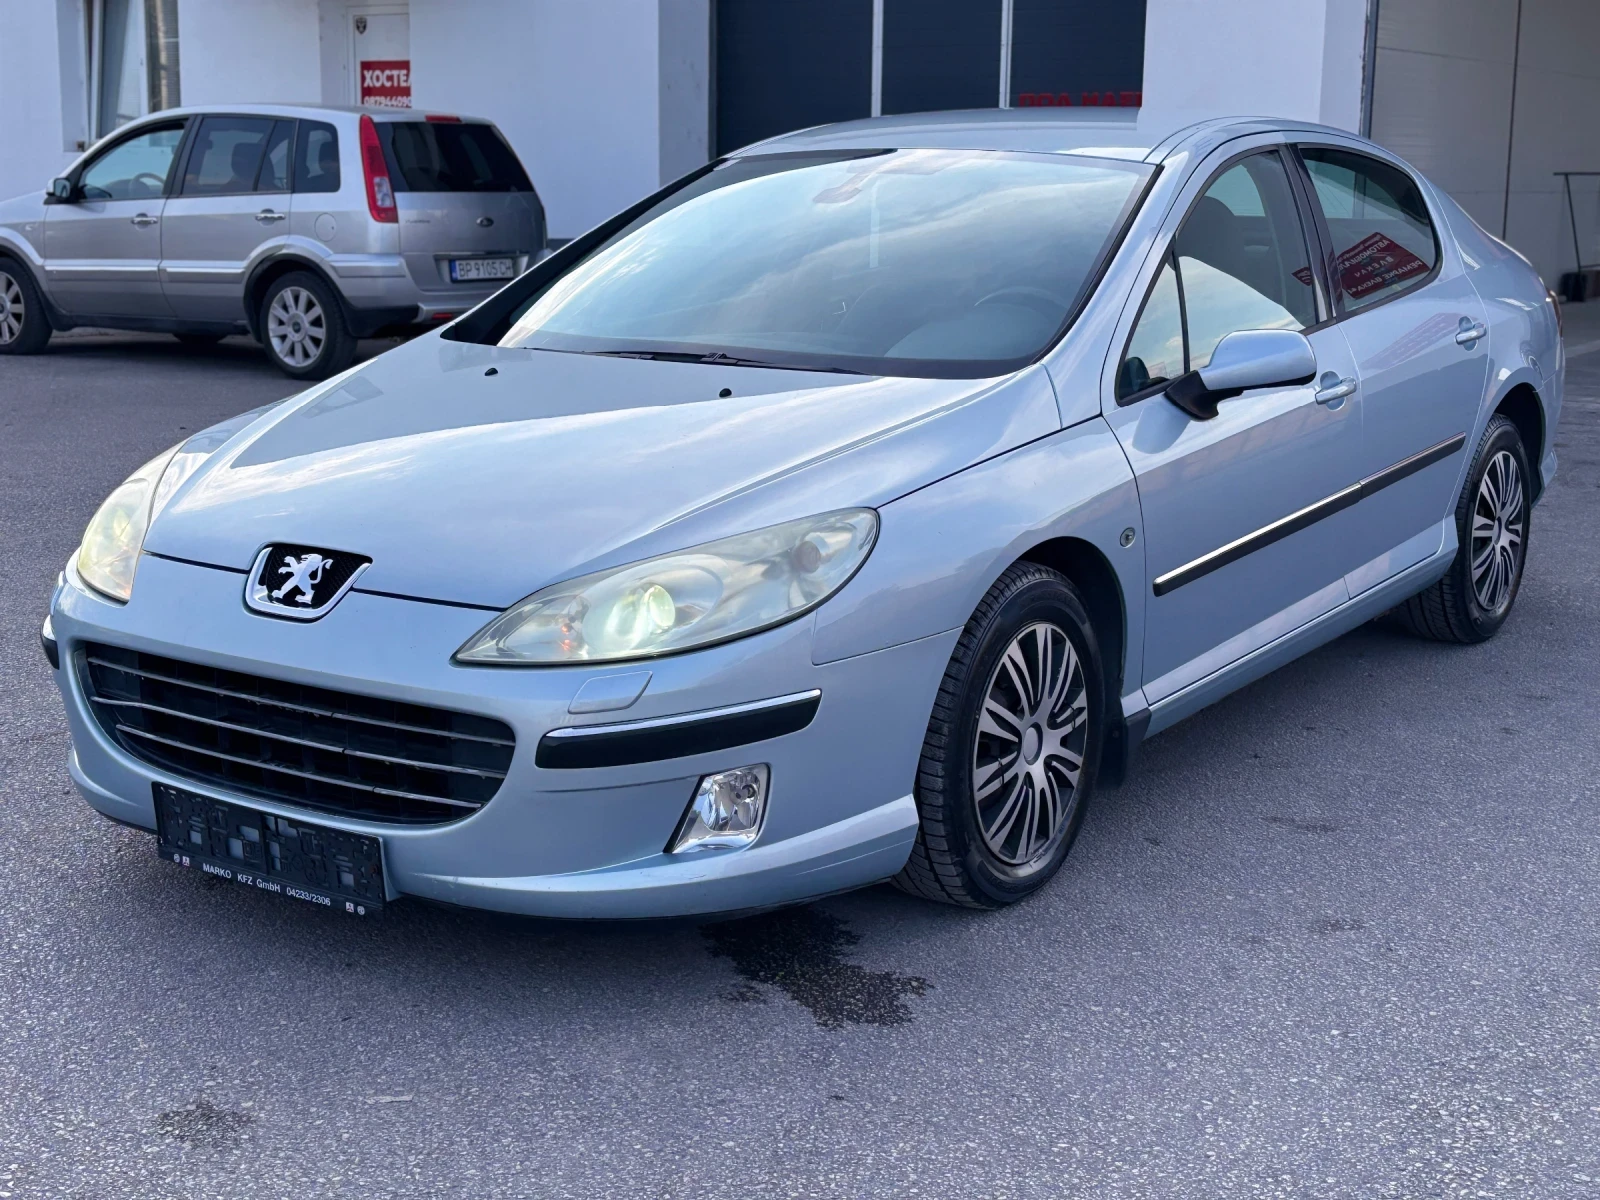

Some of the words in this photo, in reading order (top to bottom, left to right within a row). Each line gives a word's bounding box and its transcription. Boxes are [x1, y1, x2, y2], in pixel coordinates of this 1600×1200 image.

[458, 262, 472, 278] BP
[474, 261, 498, 277] 9105
[202, 862, 232, 880] MARKO
[237, 873, 253, 886] KFZ
[256, 878, 281, 894] GmbH
[286, 887, 331, 907] 04233/2306
